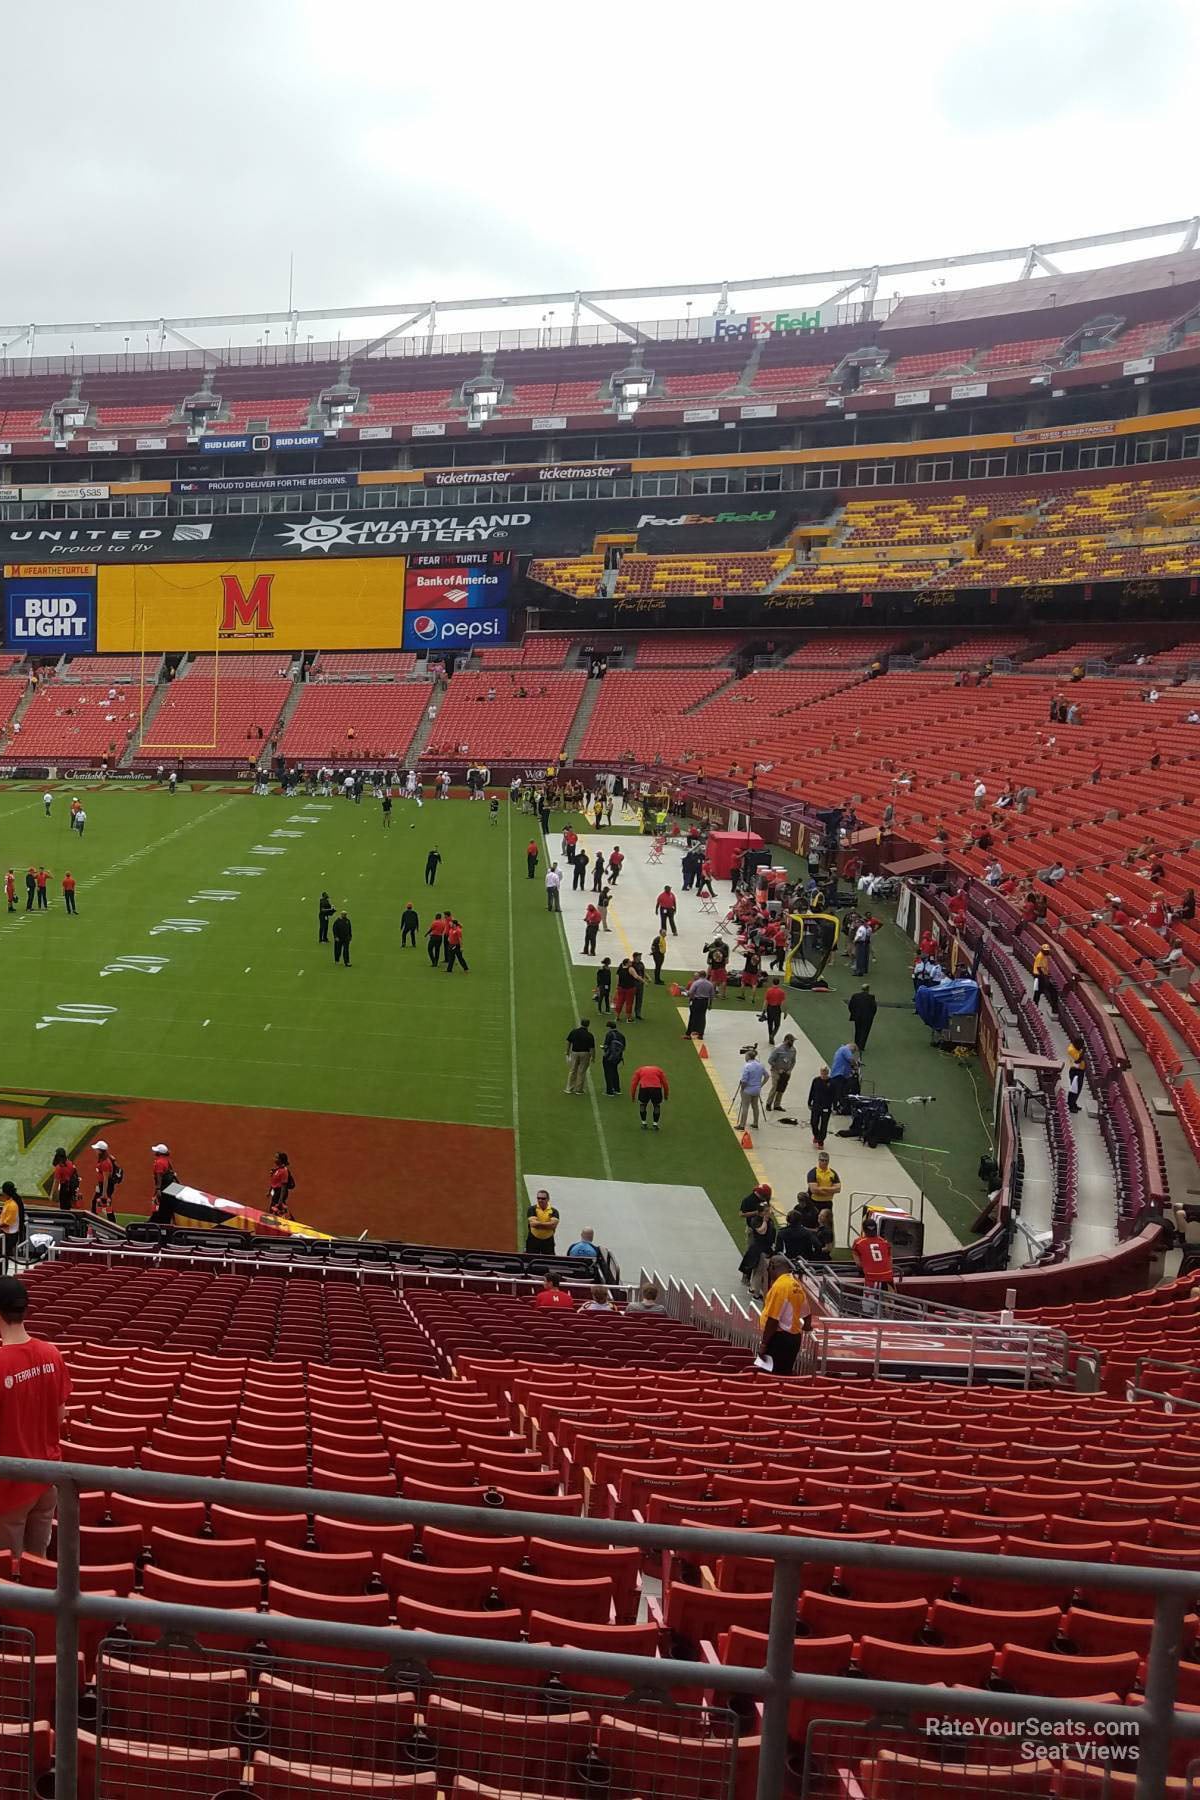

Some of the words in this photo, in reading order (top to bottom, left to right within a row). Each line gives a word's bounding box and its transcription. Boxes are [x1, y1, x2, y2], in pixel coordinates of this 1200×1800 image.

[715, 311, 820, 337] FedExField
[204, 441, 221, 449] BUD
[222, 440, 247, 448] LIGHT
[275, 438, 293, 446] BUD
[294, 436, 319, 445] LIGHT
[436, 471, 511, 484] ticketmaster
[539, 466, 616, 480] ticketmaster
[208, 482, 234, 490] PROUD
[234, 481, 244, 489] TO
[245, 480, 276, 488] DELIVER
[277, 479, 292, 487] FOR
[292, 478, 307, 486] THE
[363, 513, 531, 533] MARYLAND
[637, 511, 776, 528] FedExField
[10, 530, 162, 540] UNITED
[358, 527, 496, 545] LOTTERY
[50, 544, 103, 554] Proud
[108, 544, 125, 552] to
[131, 543, 153, 553] fly
[23, 567, 89, 575] #FEARTHETURTLE
[417, 575, 443, 586] Bank
[443, 575, 455, 586] of
[455, 574, 498, 585] America
[25, 598, 77, 617] BUD
[219, 574, 275, 630] M
[15, 618, 87, 637] LIGHT
[441, 618, 499, 640] pepsi
[152, 918, 209, 933] 30
[104, 954, 170, 974] 20
[41, 1003, 118, 1025] 10
[870, 1244, 882, 1261] 6
